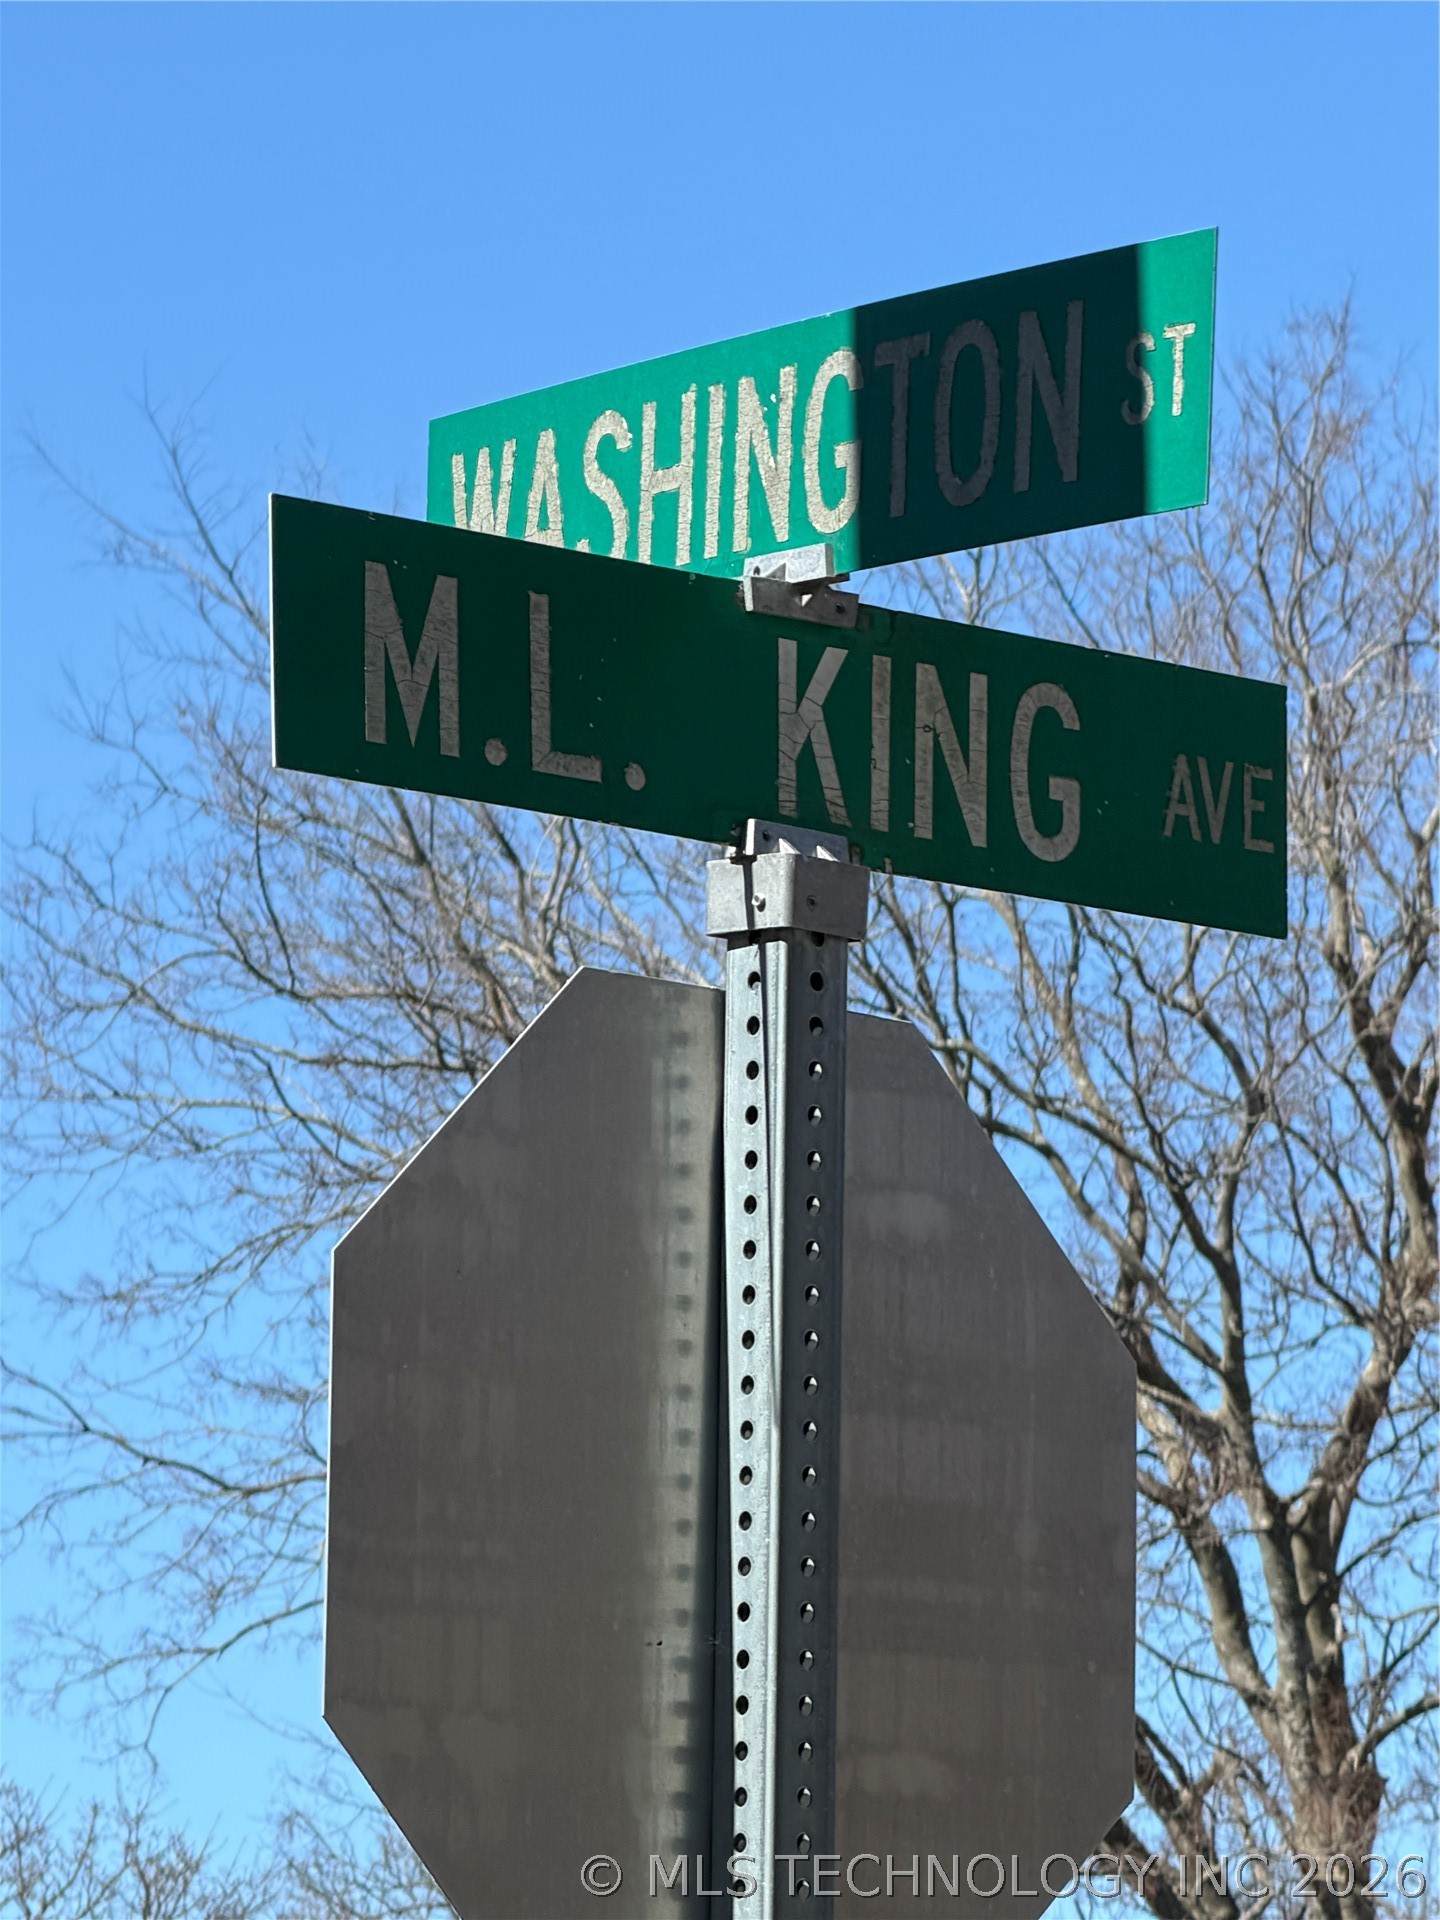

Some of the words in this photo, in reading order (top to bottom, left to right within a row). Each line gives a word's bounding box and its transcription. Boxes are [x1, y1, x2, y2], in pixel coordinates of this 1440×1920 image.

[451, 299, 1084, 567] WASHINGTON
[1120, 321, 1197, 426] ST
[364, 560, 647, 792] M.L.
[777, 637, 1082, 863] KING
[1162, 753, 1276, 854] AVE
